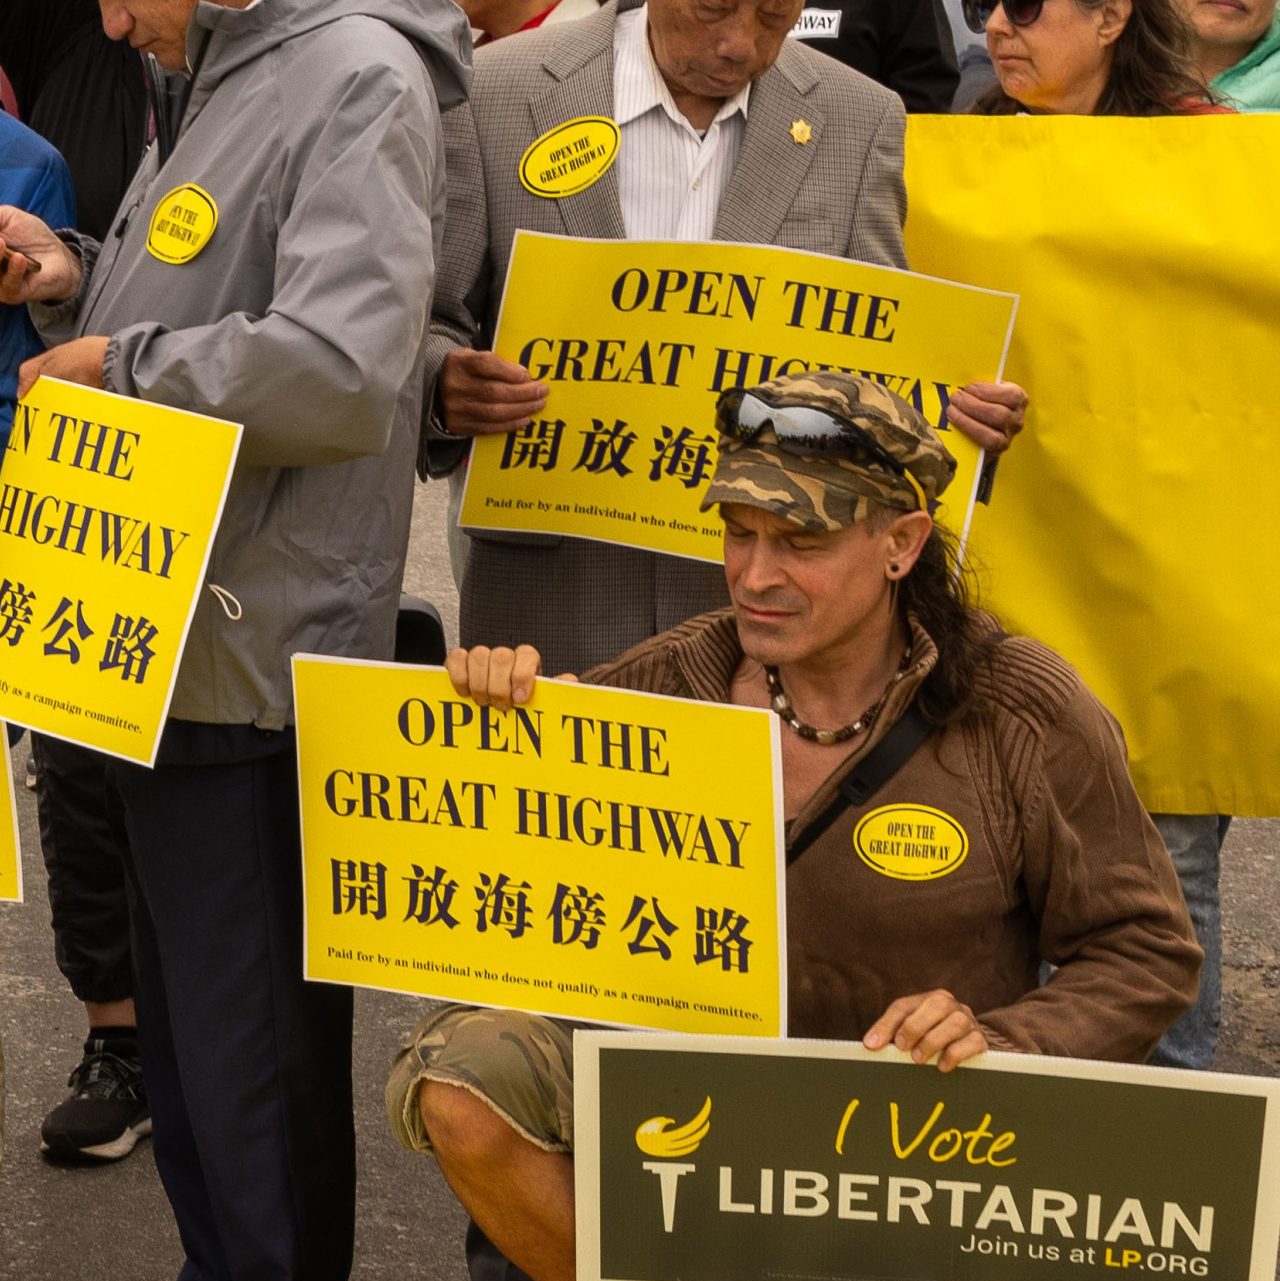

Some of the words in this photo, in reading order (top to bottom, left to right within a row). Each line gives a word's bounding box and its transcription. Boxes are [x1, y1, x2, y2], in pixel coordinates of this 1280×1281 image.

[540, 164, 568, 184] GREAT
[569, 144, 606, 172] HIGHWAY
[550, 145, 573, 164] OPEN
[573, 136, 590, 154] THE
[612, 268, 765, 321] OPEN
[784, 281, 899, 342] THE
[518, 338, 695, 388] GREAT
[48, 413, 140, 481] THE
[397, 698, 544, 758] OPEN
[562, 714, 670, 777] THE
[325, 770, 495, 830] GREAT
[515, 788, 751, 868] HIGHWAY
[870, 840, 902, 856] GREAT
[904, 842, 950, 861] HIGHWAY
[887, 822, 913, 838] OPEN
[916, 825, 936, 840] THE
[329, 858, 753, 974] 開放海傍公路
[834, 1099, 859, 1156] I
[889, 1100, 1017, 1168] Vote
[719, 1166, 1214, 1253] LIBERTARIAN
[960, 1235, 1020, 1257] Join
[1028, 1242, 1061, 1262] us
[1070, 1245, 1095, 1266] at
[1104, 1247, 1210, 1277] LP.ORG
